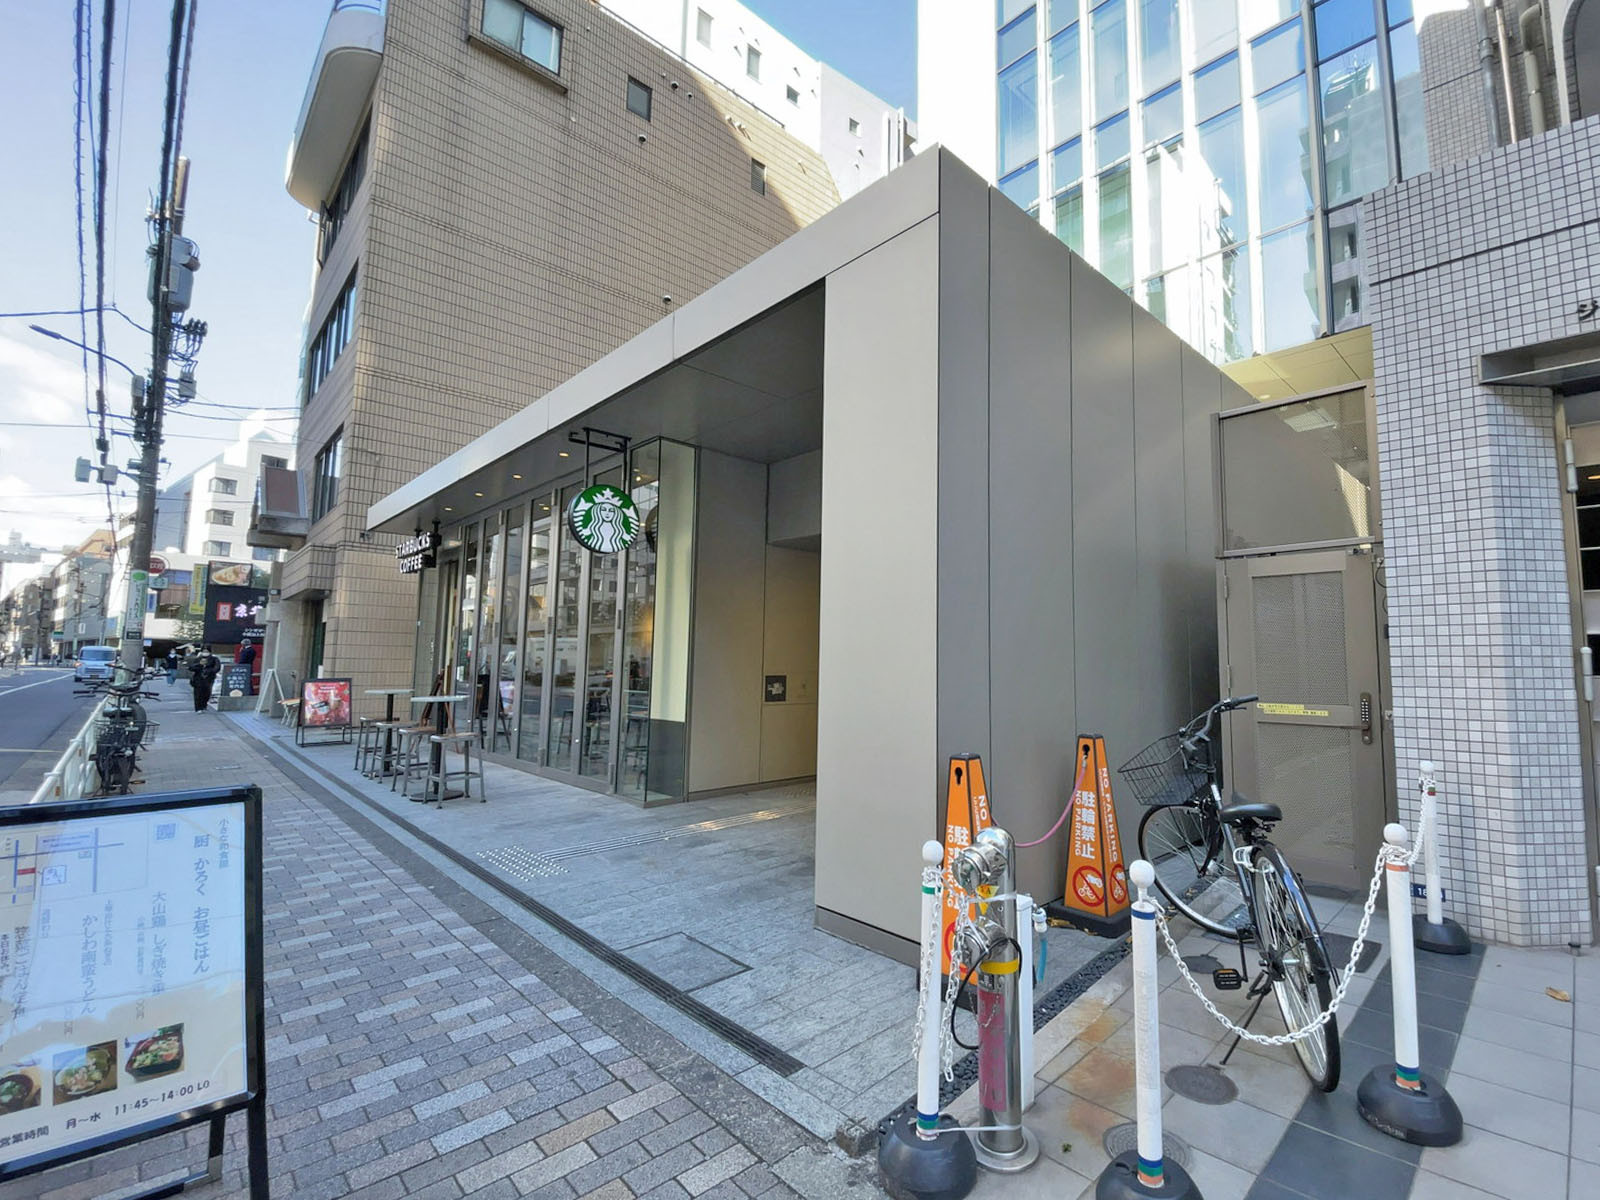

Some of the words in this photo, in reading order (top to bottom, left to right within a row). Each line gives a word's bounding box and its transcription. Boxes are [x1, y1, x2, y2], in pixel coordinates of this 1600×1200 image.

[400, 553, 423, 573] COFFEE
[1102, 767, 1109, 788] NO
[978, 795, 988, 820] NO
[1075, 790, 1082, 805] NO
[947, 824, 954, 844] NO
[1081, 790, 1096, 860] 駐輪禁止
[1105, 793, 1118, 862] PARKING
[193, 906, 210, 975] お昼ごはん
